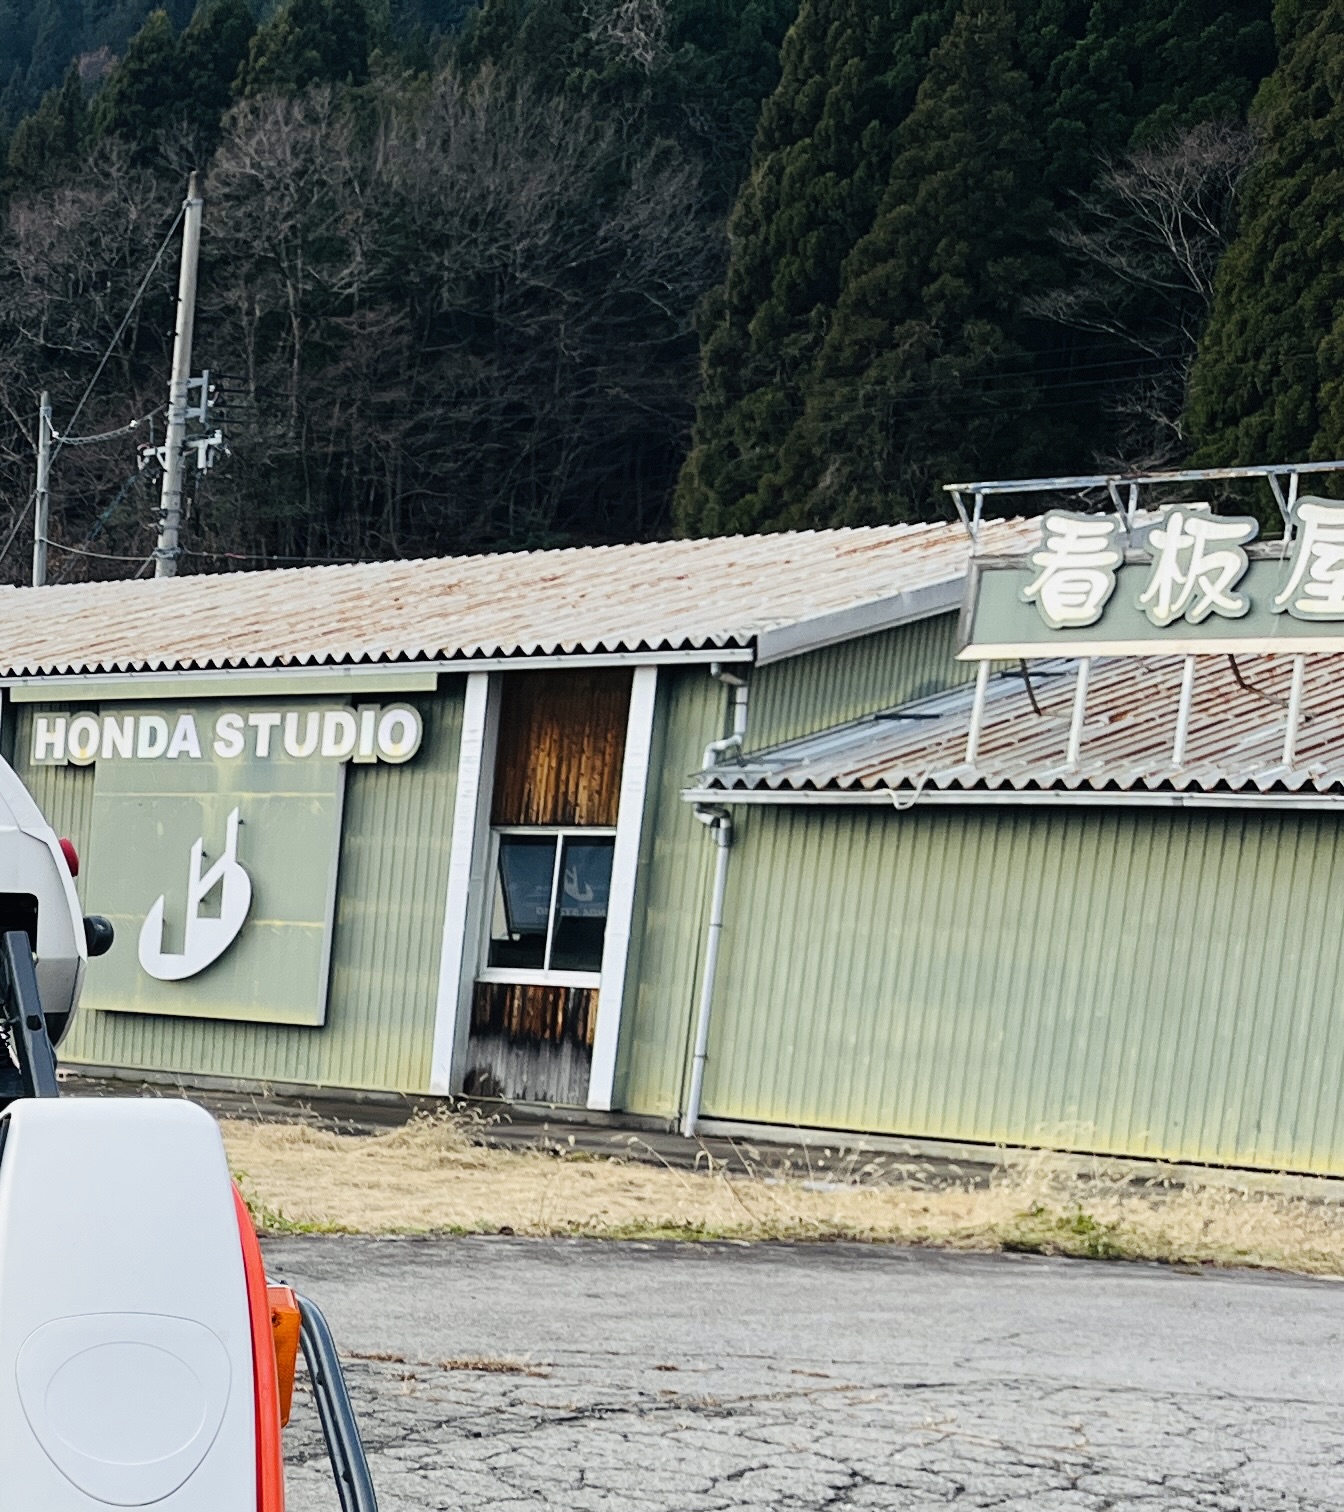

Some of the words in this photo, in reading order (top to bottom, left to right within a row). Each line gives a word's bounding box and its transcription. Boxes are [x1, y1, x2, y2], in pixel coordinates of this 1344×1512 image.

[1023, 503, 1344, 623] 看板屋
[34, 713, 202, 760] HONDA
[213, 708, 418, 759] STUDIO
